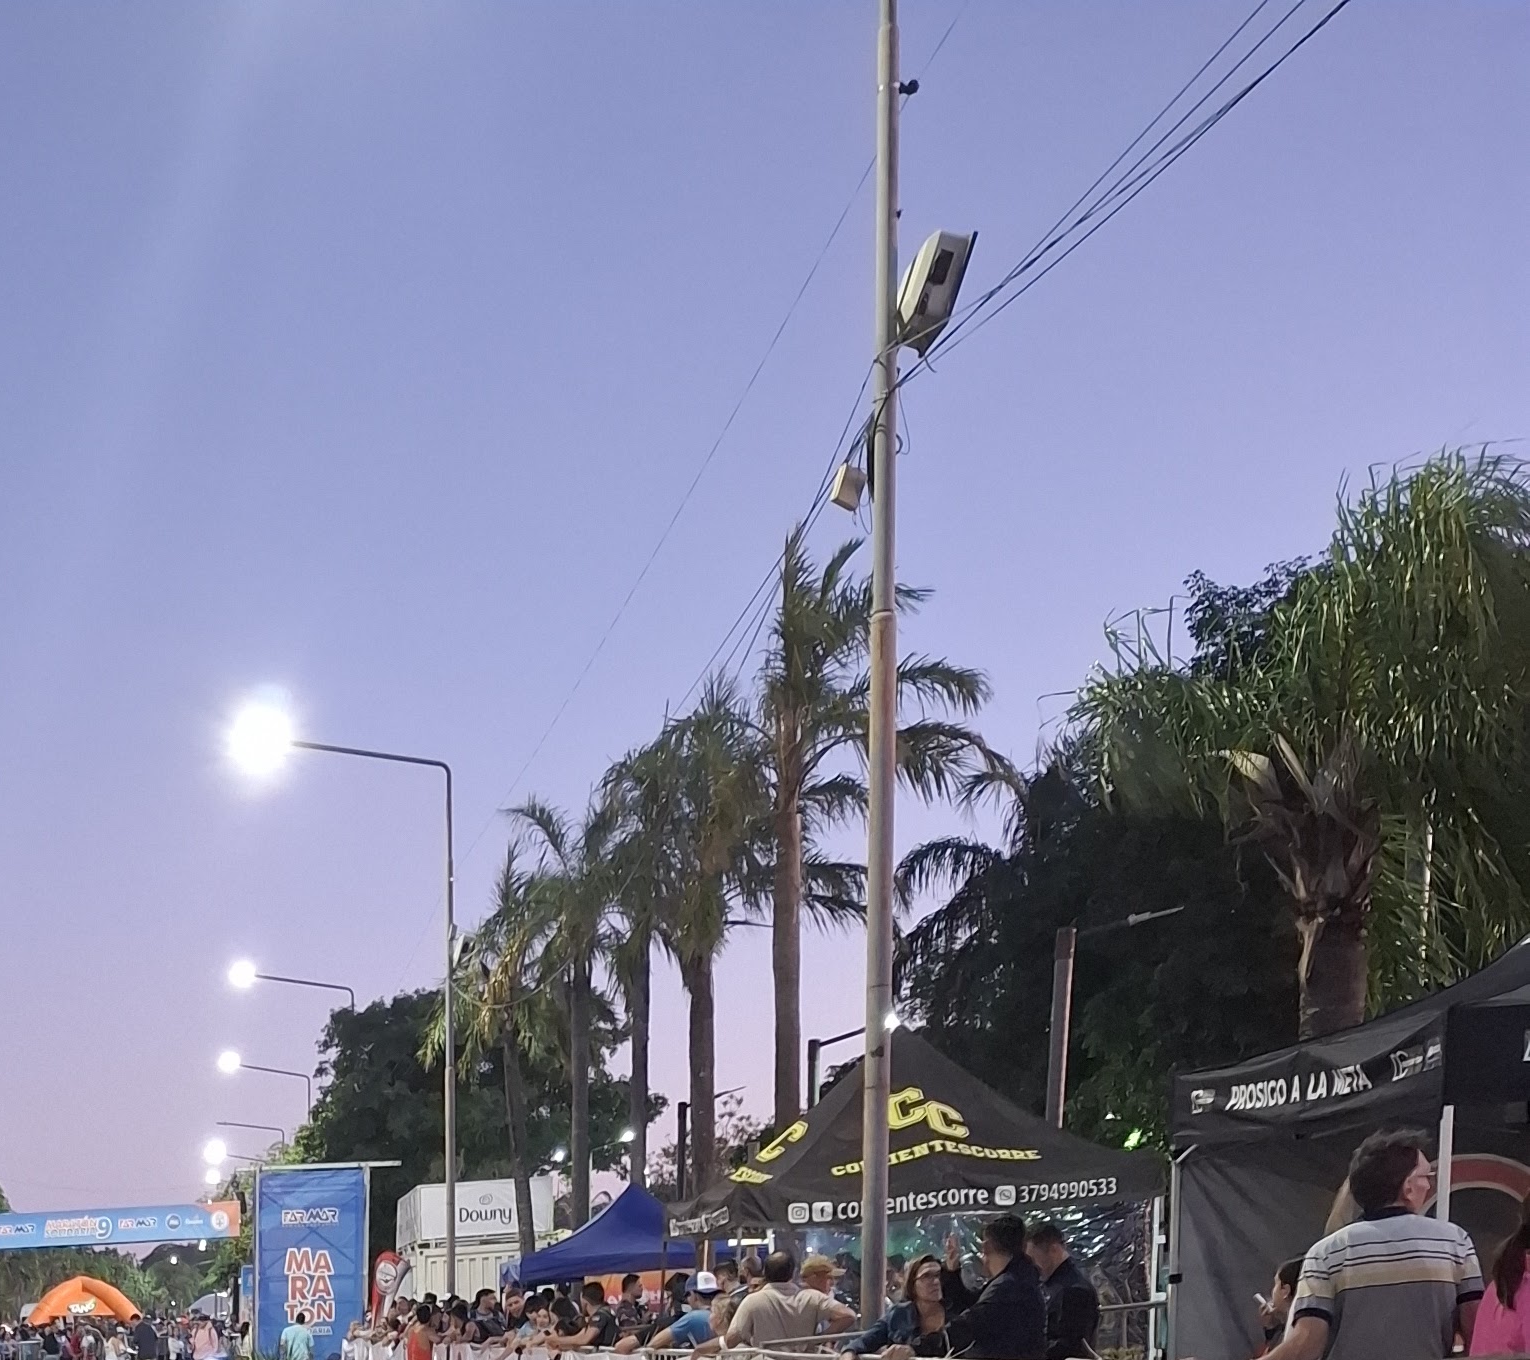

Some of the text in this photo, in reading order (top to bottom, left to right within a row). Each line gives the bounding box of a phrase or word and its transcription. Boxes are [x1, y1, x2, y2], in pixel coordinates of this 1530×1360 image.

[1225, 1078, 1286, 1111] PROSIGO
[1289, 1075, 1300, 1104] A
[1306, 1071, 1327, 1102] LA
[1331, 1064, 1373, 1097] META
[830, 1139, 1043, 1177] COIENTESCORRE
[837, 1177, 1118, 1220] coentescorre 3794990533
[96, 1216, 113, 1239] 9
[458, 1206, 512, 1225] Downy
[285, 1247, 334, 1275] MA
[289, 1272, 334, 1302] RA
